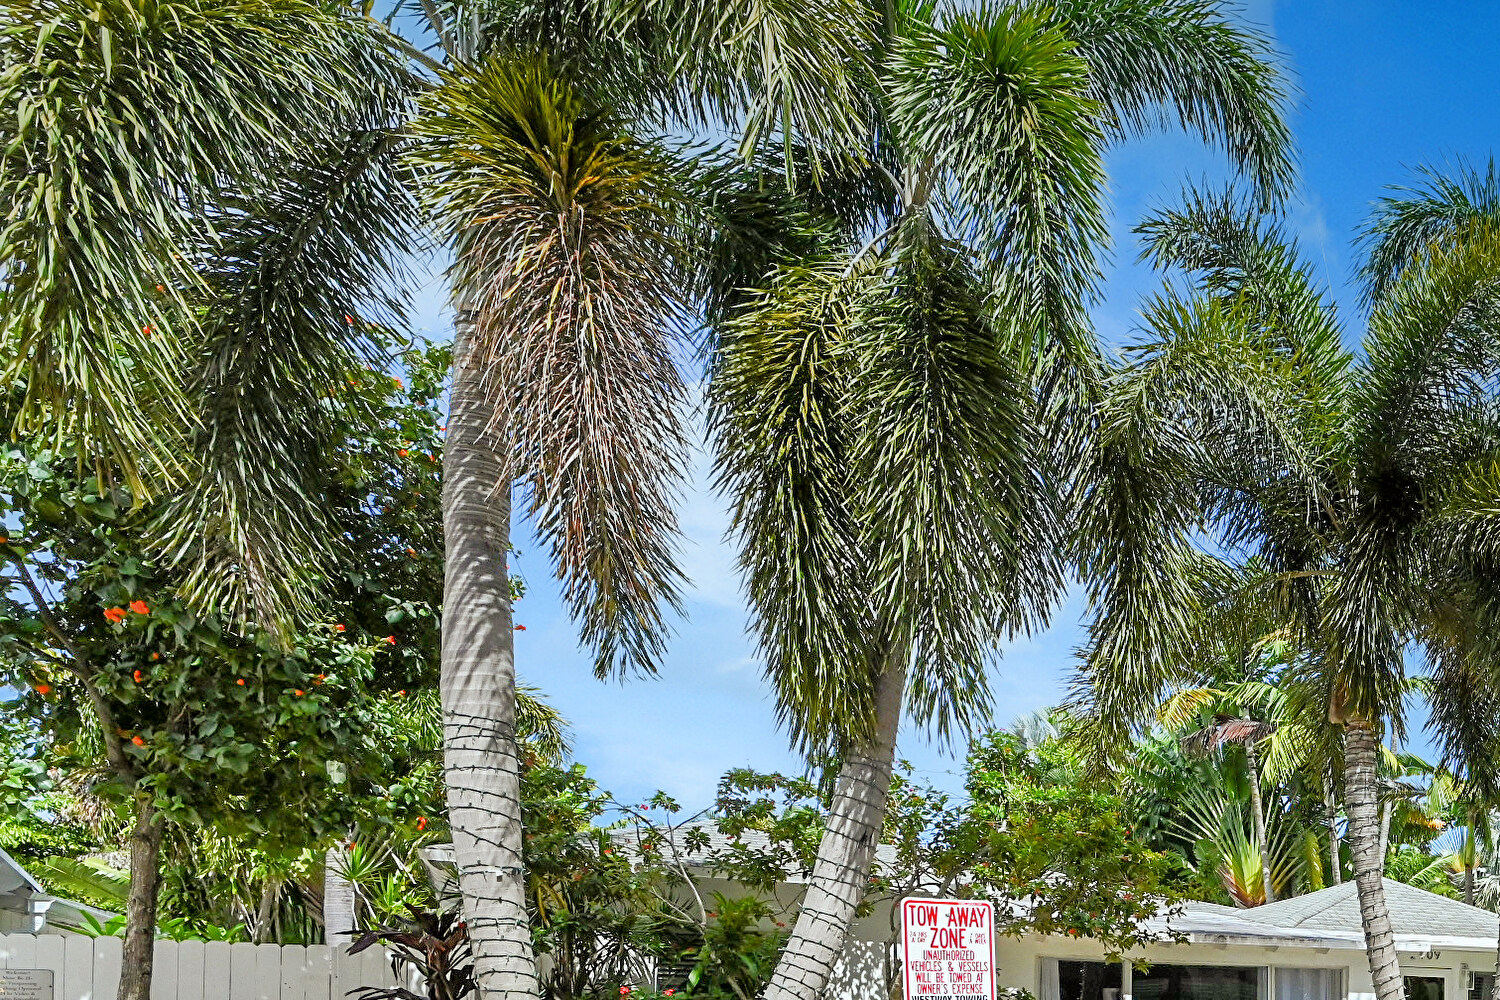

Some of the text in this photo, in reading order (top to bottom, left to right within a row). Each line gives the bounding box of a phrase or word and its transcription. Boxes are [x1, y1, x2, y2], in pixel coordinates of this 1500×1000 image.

[909, 904, 986, 928] TOW AWAY
[930, 928, 967, 949] ZONE
[923, 950, 975, 960] UNAUTHORIZED
[910, 961, 988, 972] VEHICLES & VESSELS
[915, 972, 983, 983] WILL BE TOWED AT
[917, 983, 983, 994] OWNER'S EXPENSE
